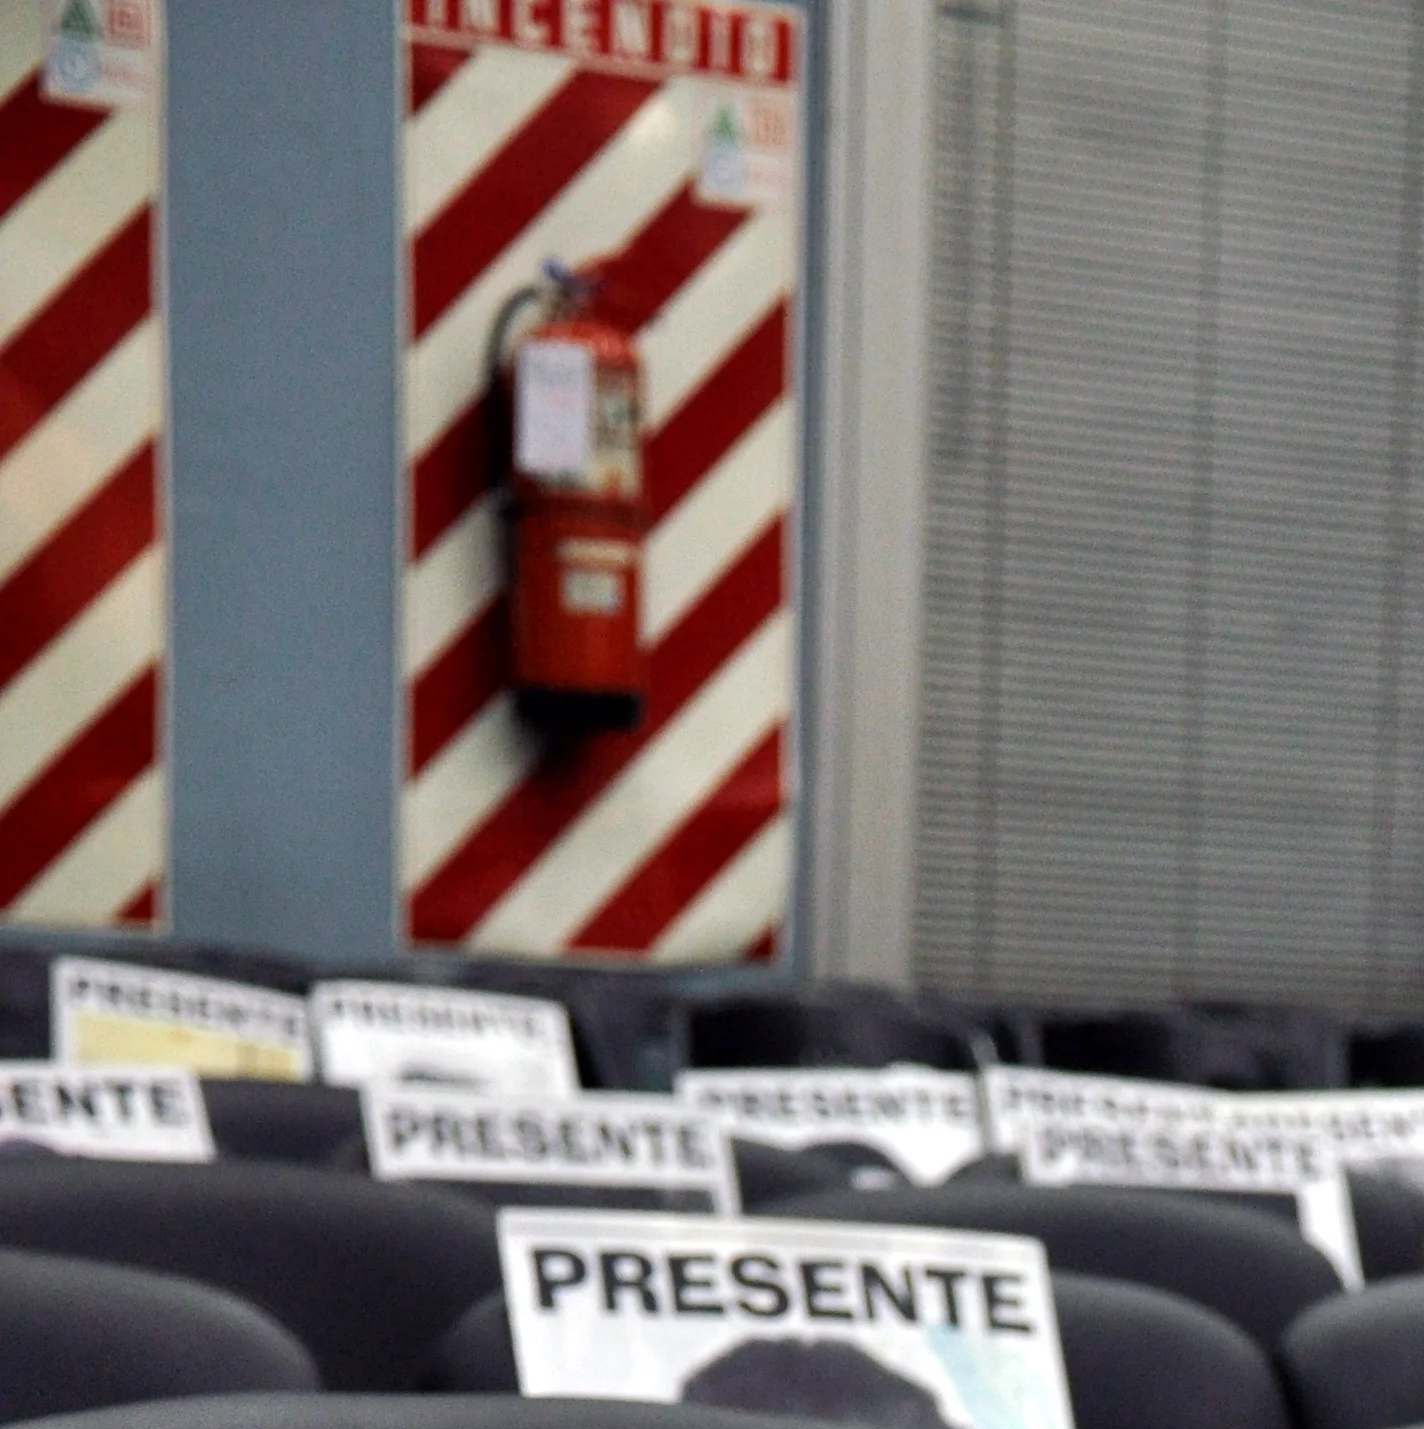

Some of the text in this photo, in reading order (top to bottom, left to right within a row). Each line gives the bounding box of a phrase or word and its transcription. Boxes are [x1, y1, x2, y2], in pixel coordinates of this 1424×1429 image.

[0, 1076, 189, 1127] ENTE
[389, 1108, 716, 1168] PRESENTE
[531, 1248, 1036, 1334] PRESENTE
